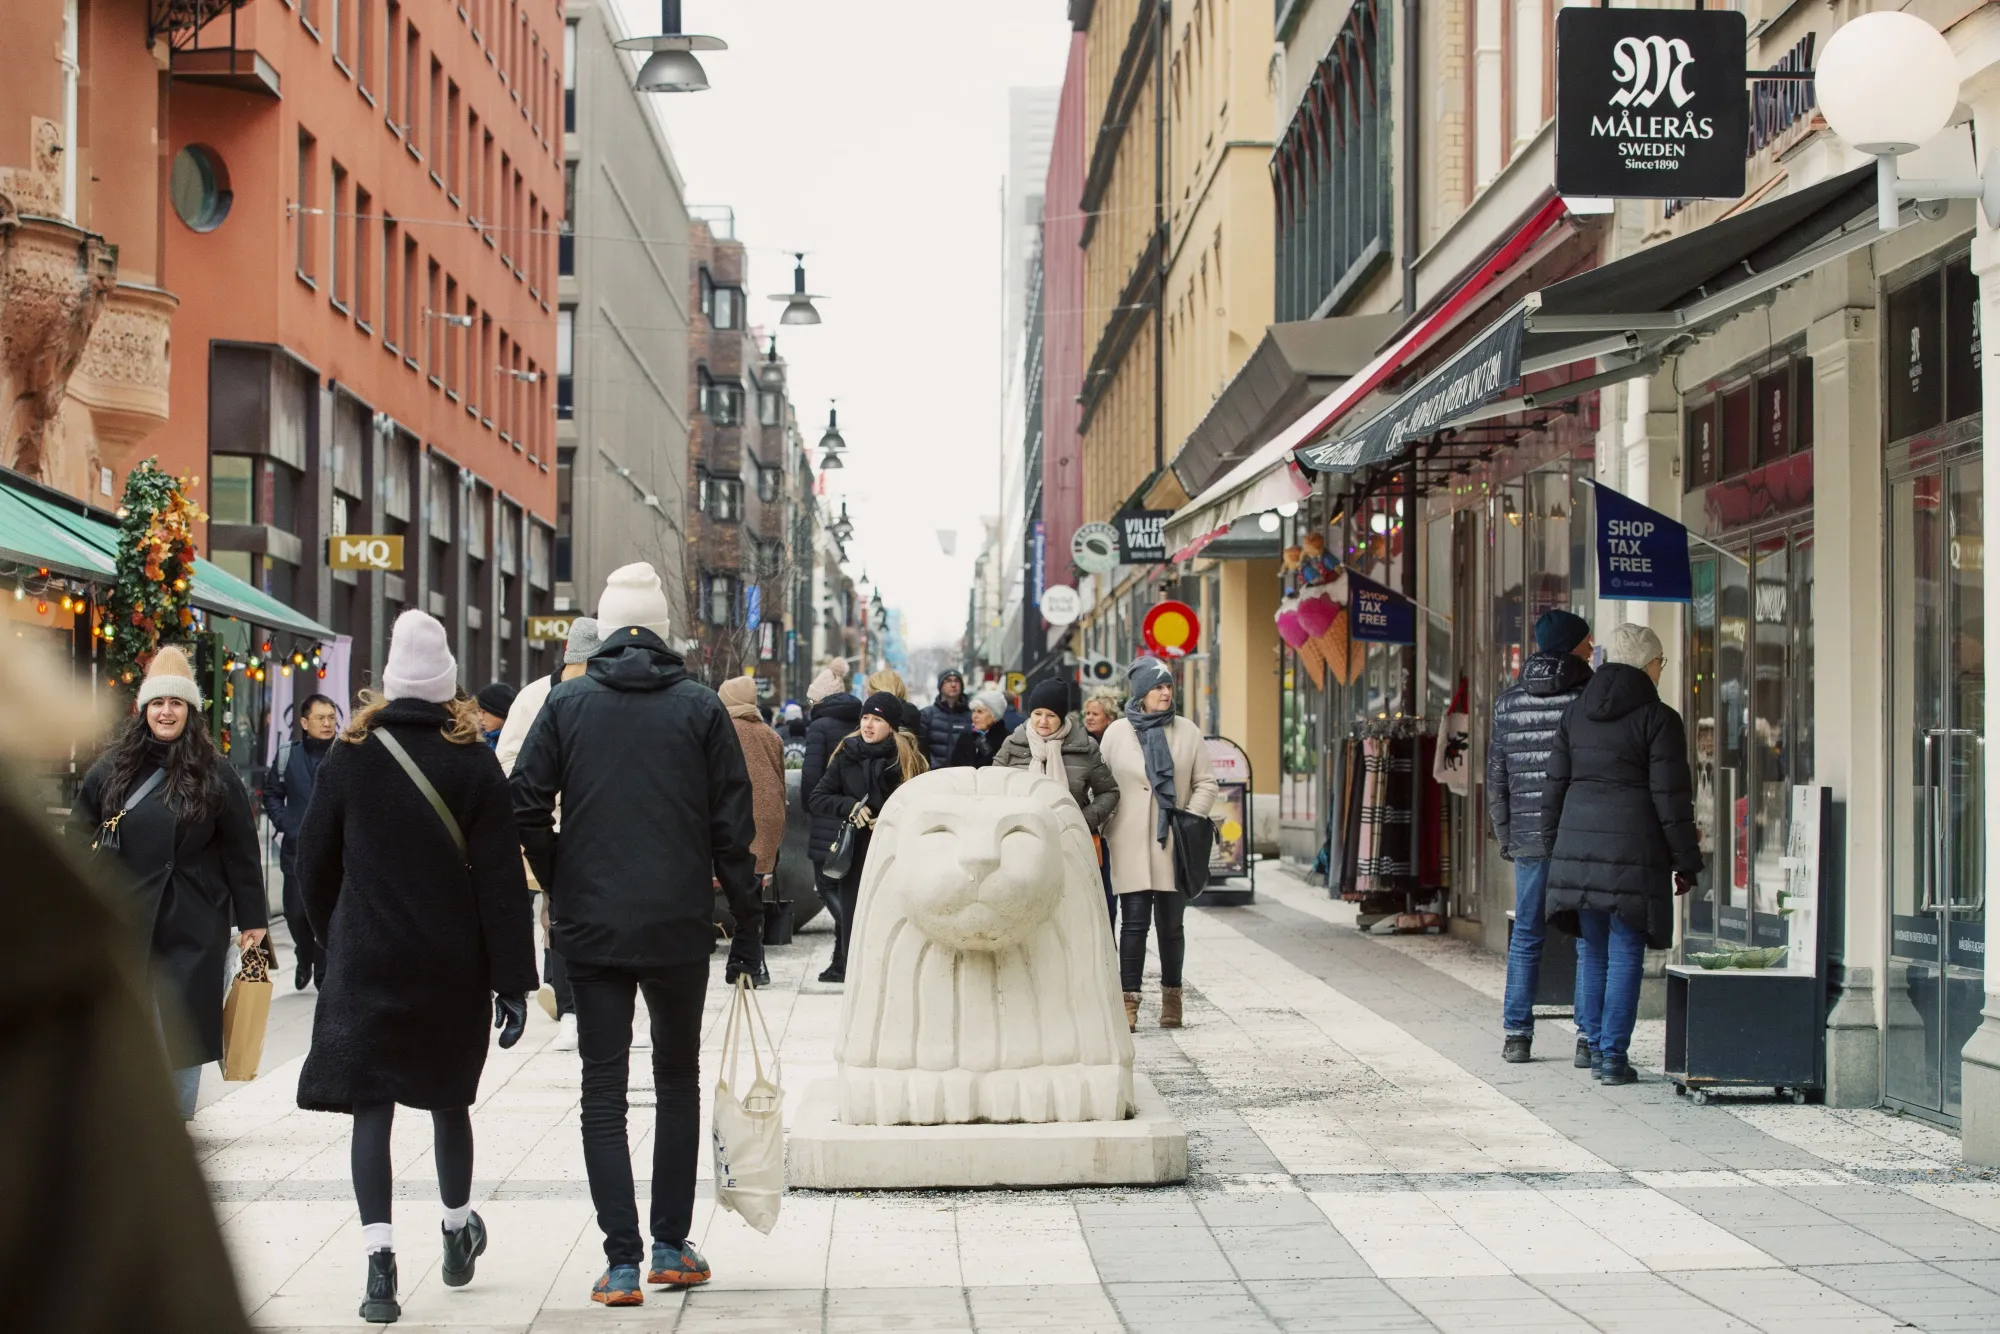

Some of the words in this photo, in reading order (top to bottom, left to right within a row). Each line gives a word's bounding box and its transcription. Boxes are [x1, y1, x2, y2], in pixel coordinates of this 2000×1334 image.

[1608, 35, 1696, 108] M
[1746, 31, 1816, 158] ASBRUK
[1590, 109, 1714, 139] MÅLERÅS
[1618, 142, 1685, 157] SWEDEN
[1625, 159, 1679, 170] Since1890
[1608, 519, 1655, 537] SHOP
[340, 539, 392, 568] MQ
[1608, 538, 1642, 555] TAX
[1609, 556, 1653, 573] FREE
[1359, 590, 1388, 601] SHOP
[1359, 600, 1382, 613] TAX
[1359, 613, 1387, 626] FREE
[534, 619, 569, 640] MQ
